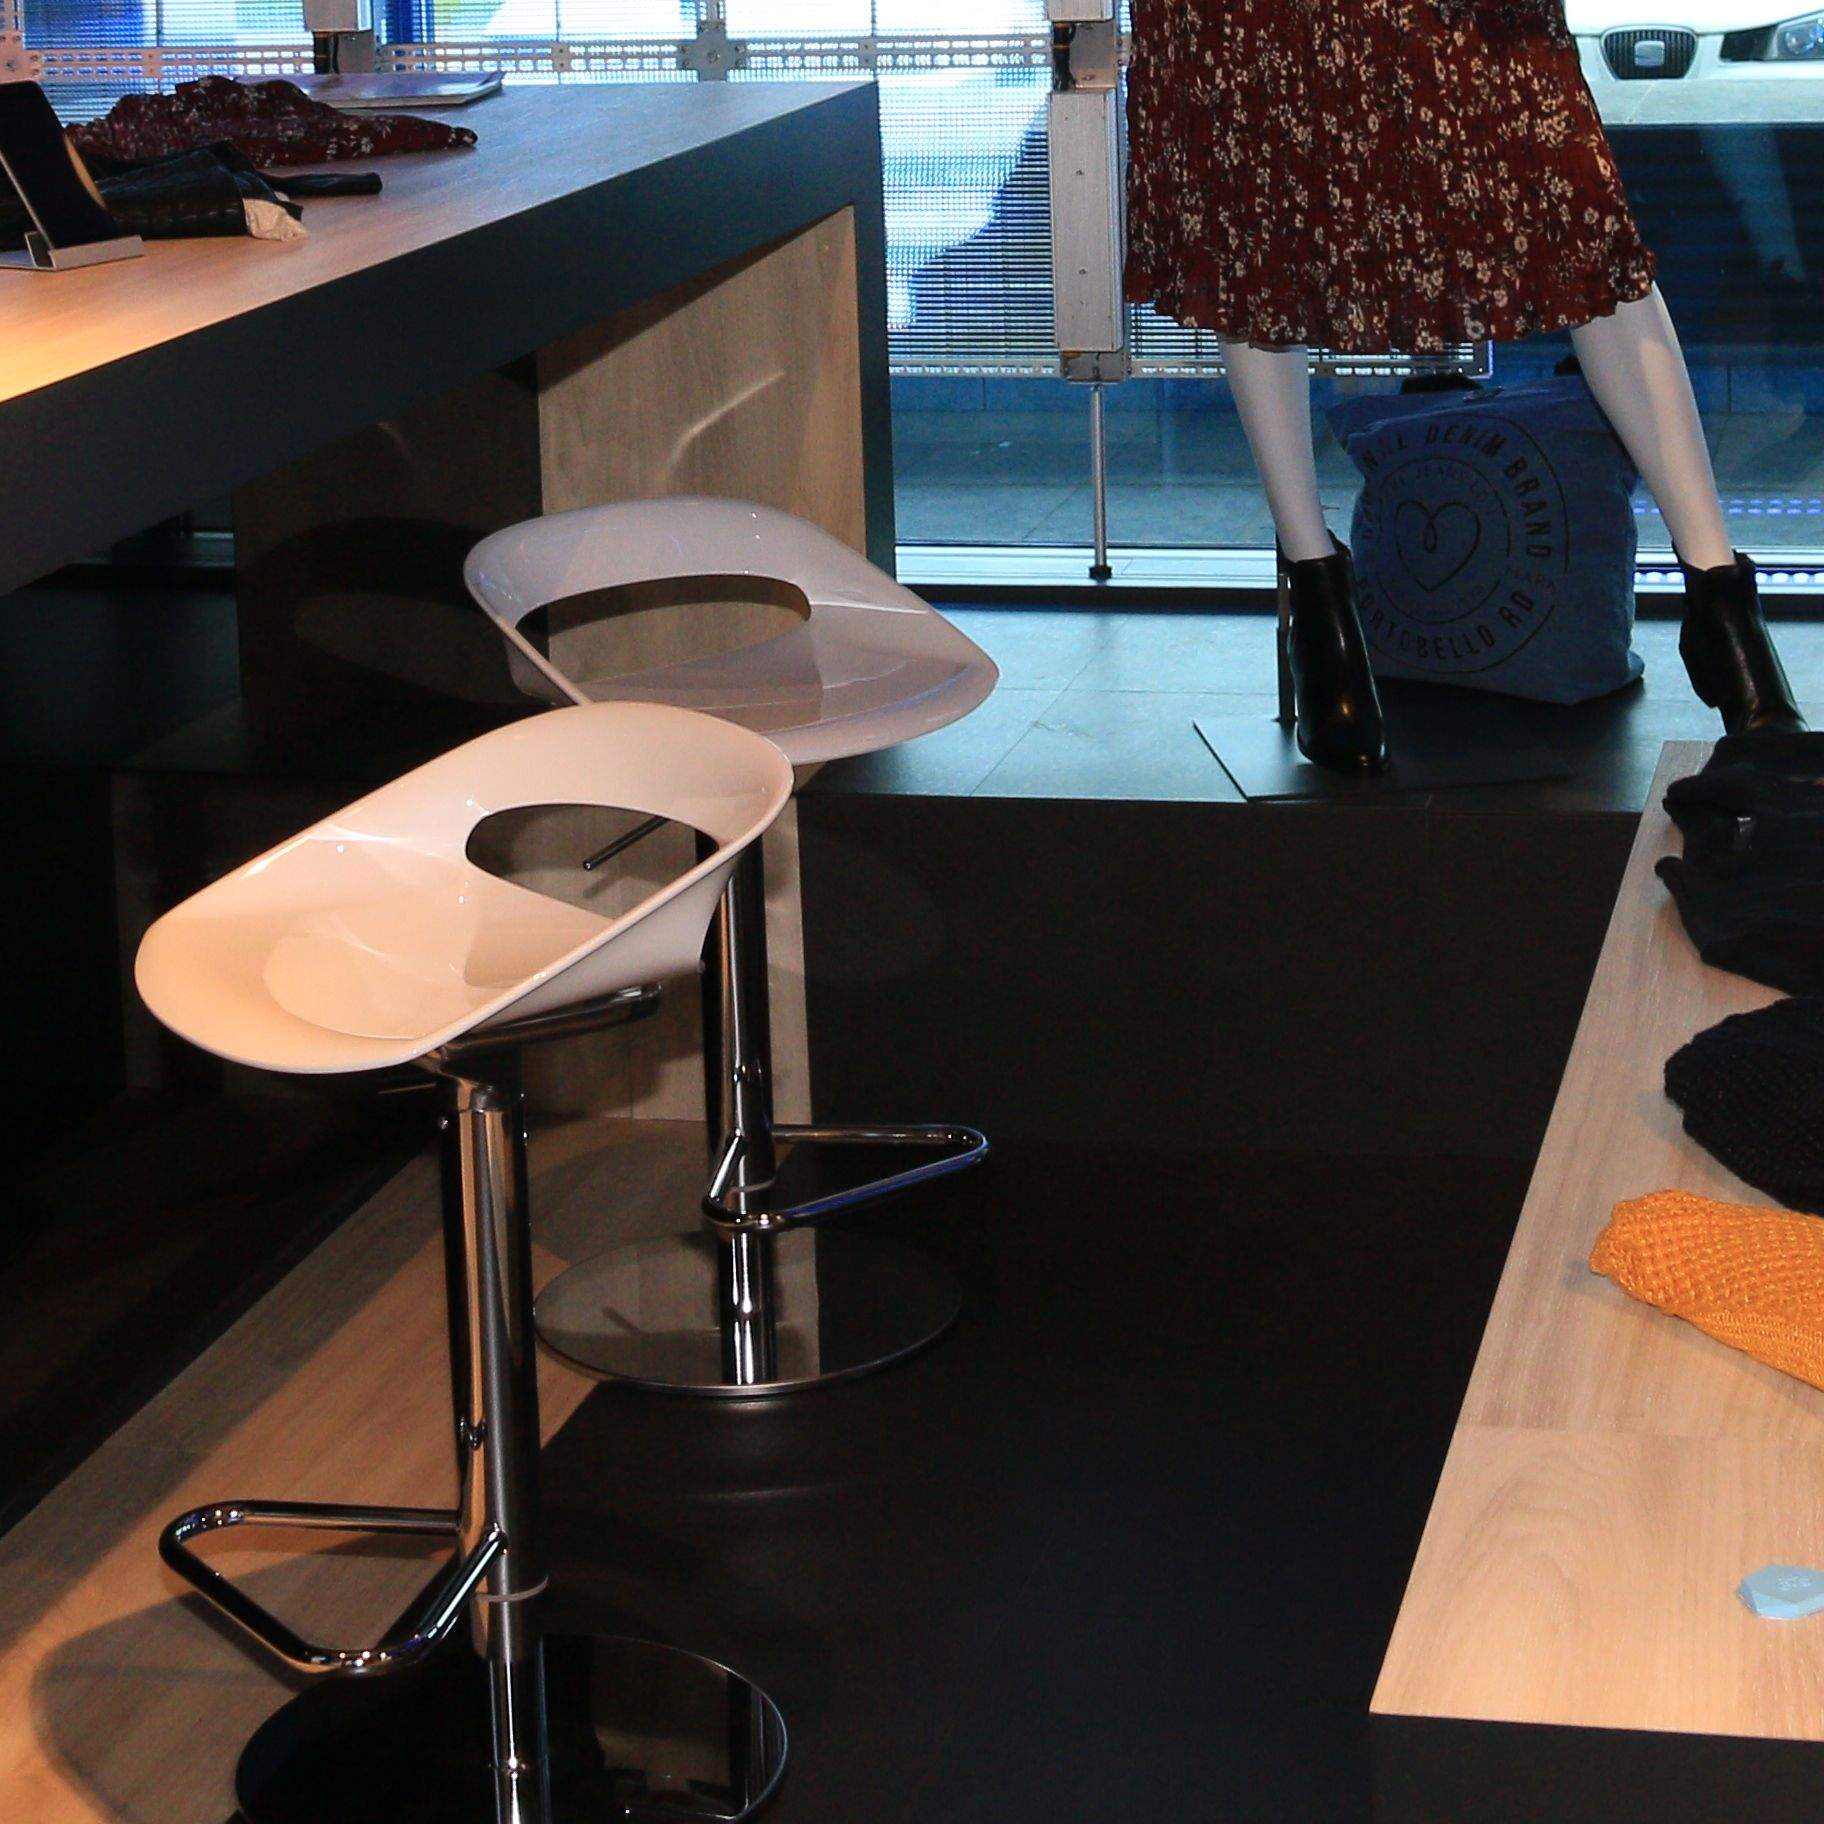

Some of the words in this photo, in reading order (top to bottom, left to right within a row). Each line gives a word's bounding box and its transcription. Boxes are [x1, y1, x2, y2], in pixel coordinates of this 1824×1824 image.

[1427, 425, 1507, 458] DENIM
[1503, 455, 1552, 558] BRAND
[1360, 577, 1495, 661] PORTOBELLO
[1498, 590, 1535, 629] RD
